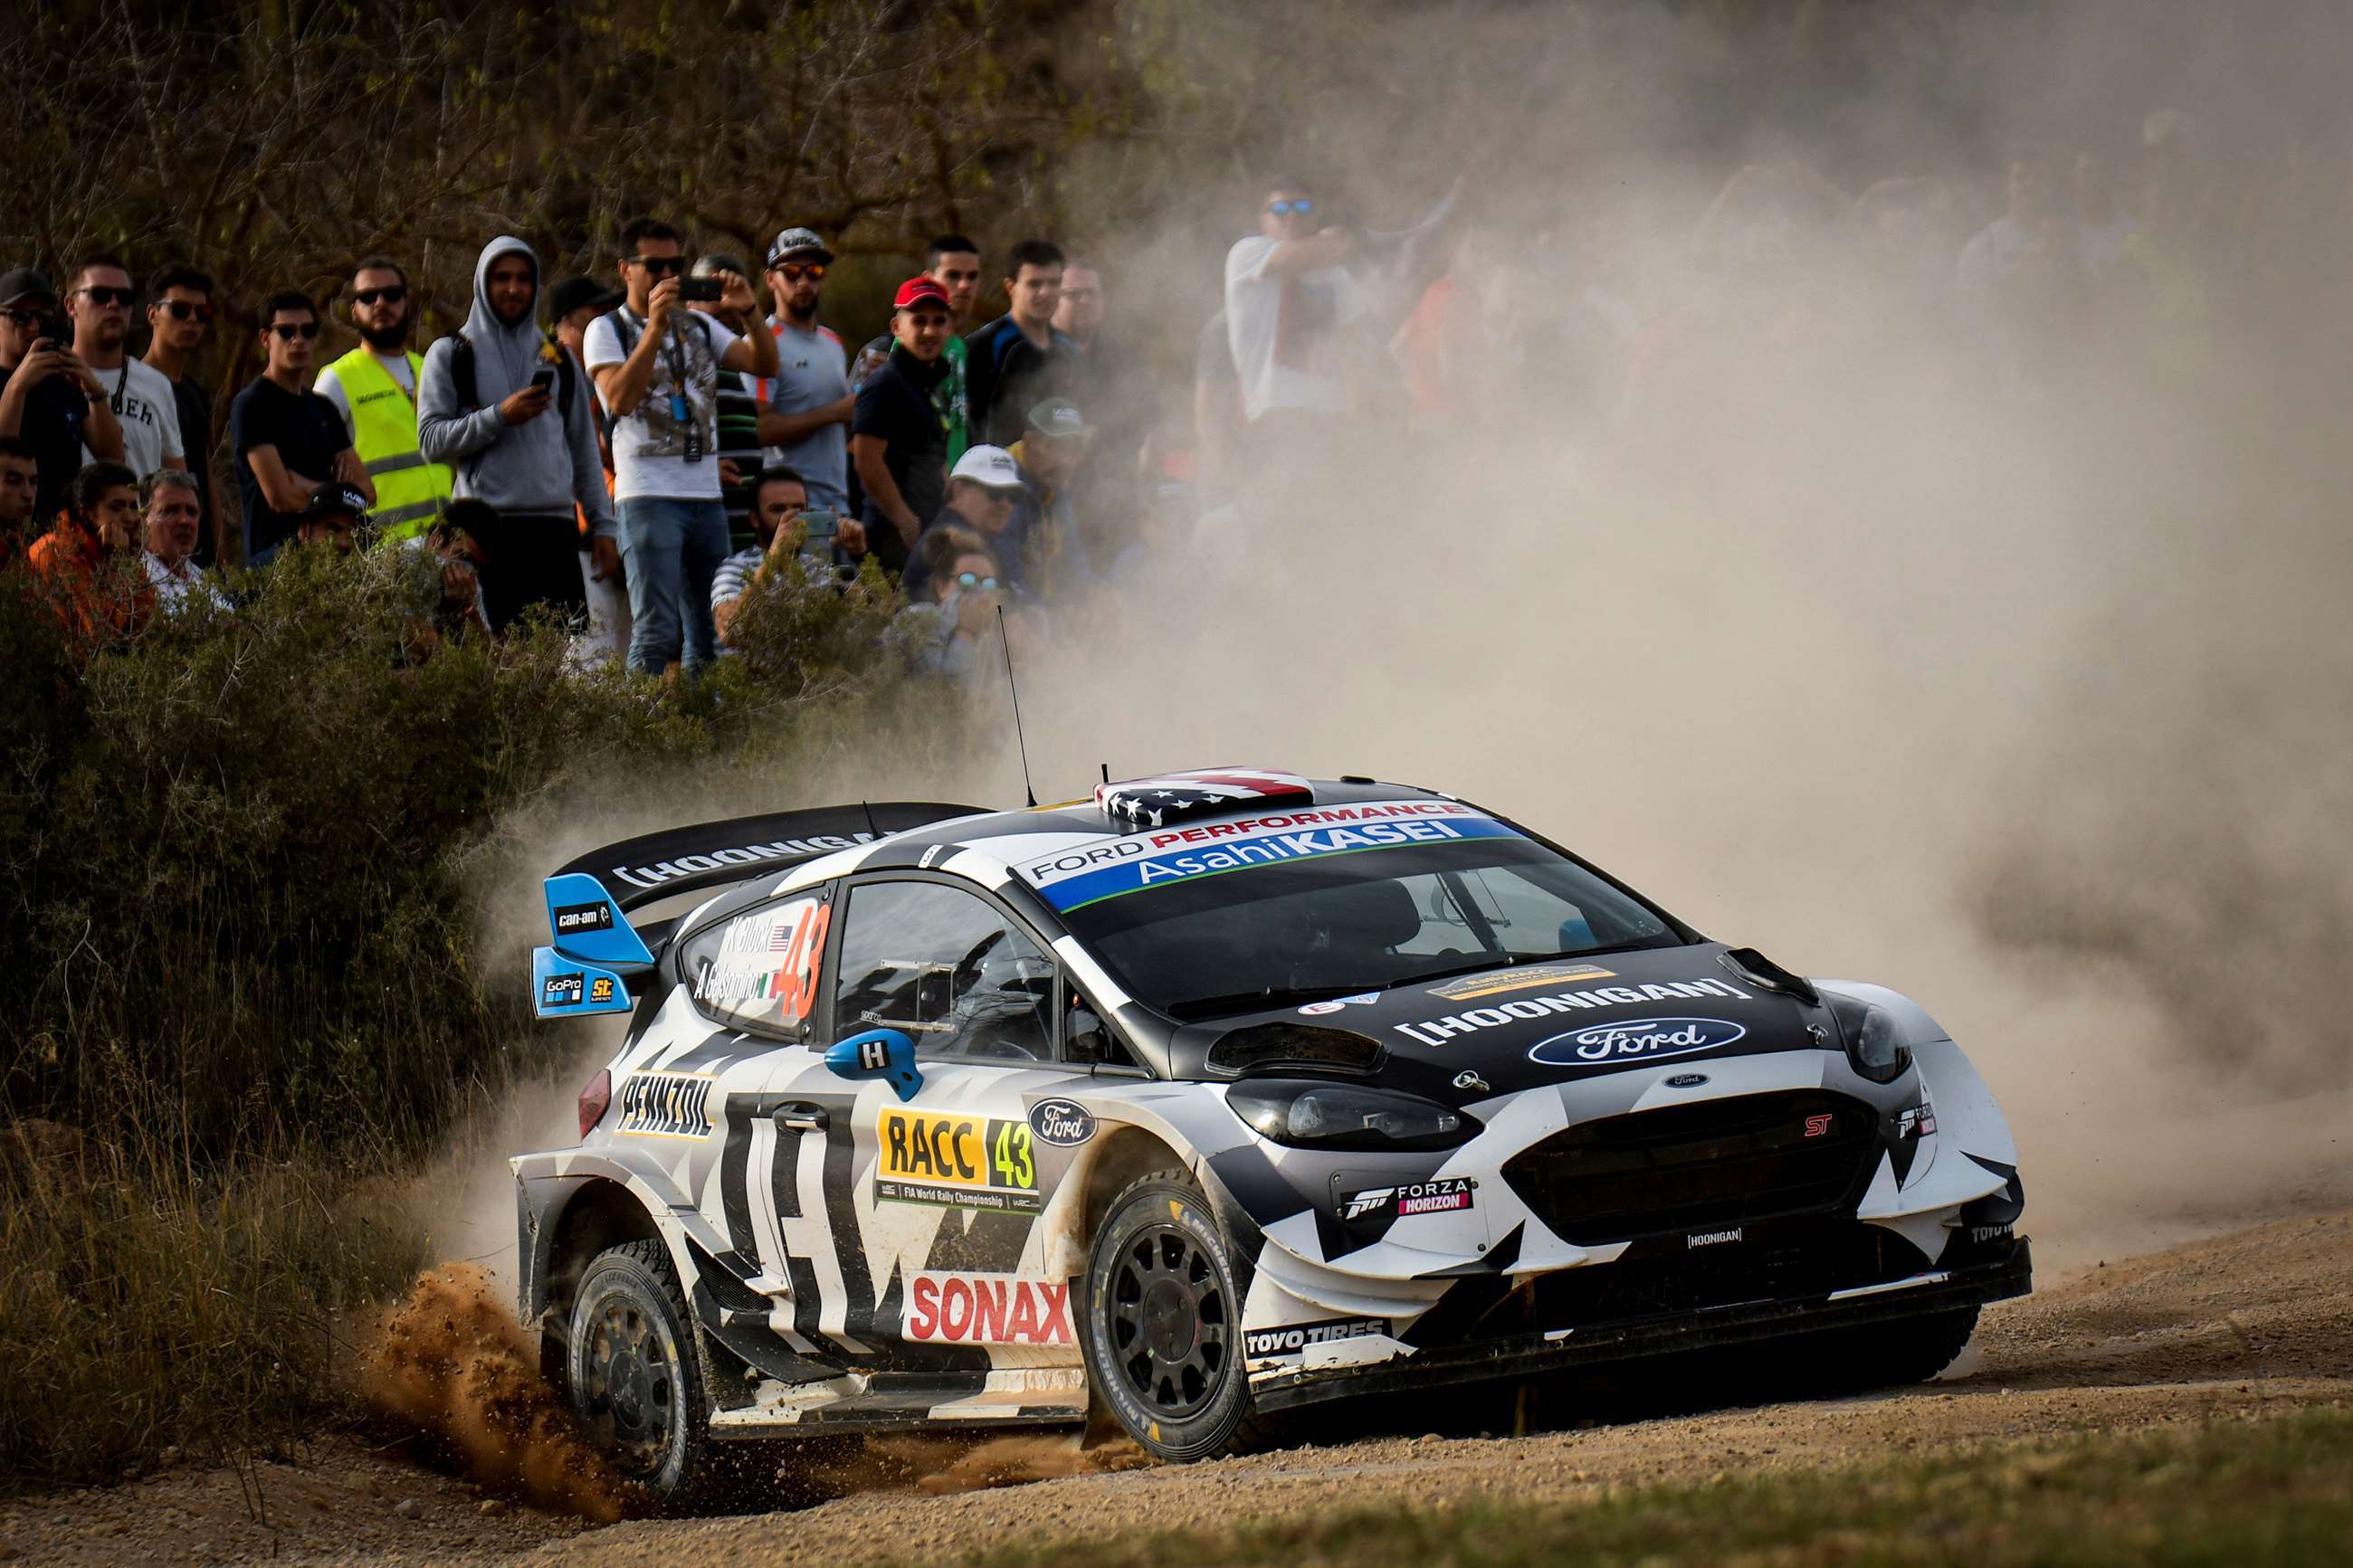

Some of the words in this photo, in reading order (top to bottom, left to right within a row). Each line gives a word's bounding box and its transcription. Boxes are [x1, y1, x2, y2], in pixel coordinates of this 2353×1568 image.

[1031, 841, 1146, 880] FORD
[1150, 803, 1471, 849] PERFORMANCE
[558, 910, 597, 927] can-am
[777, 904, 831, 1020] 43
[547, 979, 582, 992] GoPro
[693, 963, 708, 999] A
[862, 1041, 886, 1069] H
[1576, 1022, 1707, 1060] Ford
[1673, 1074, 1703, 1087] Ford
[617, 1075, 713, 1136] PENNZOIL
[1041, 1104, 1084, 1139] Ford
[1804, 1113, 1834, 1138] ST
[888, 1115, 976, 1180] RACC
[996, 1121, 1034, 1190] 43
[904, 1186, 916, 1198] FIA
[916, 1187, 936, 1201] World
[937, 1190, 954, 1203] Rally
[955, 1192, 1004, 1209] Championship
[1397, 1179, 1468, 1199] FORZA
[1405, 1194, 1461, 1213] HORIZON
[910, 1277, 1073, 1345] SONAX
[1247, 1330, 1305, 1354] TOYO
[1308, 1319, 1384, 1344] TIRES
